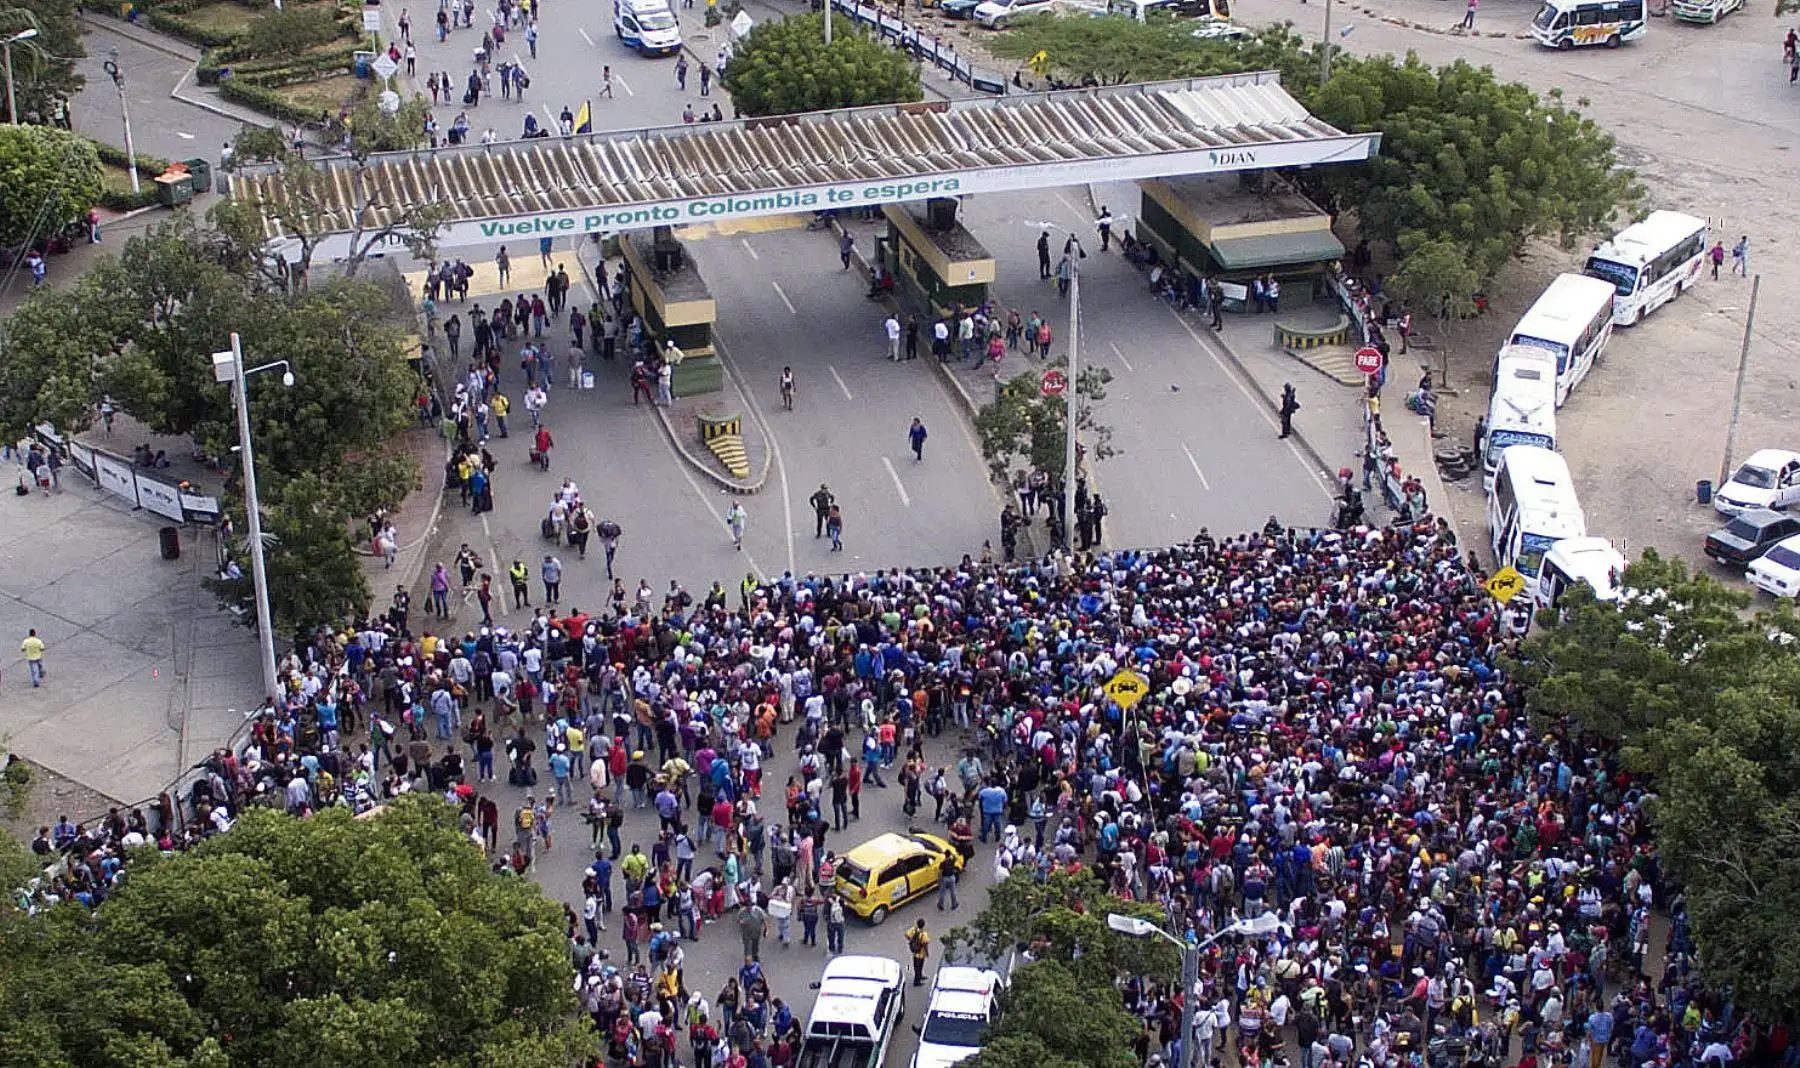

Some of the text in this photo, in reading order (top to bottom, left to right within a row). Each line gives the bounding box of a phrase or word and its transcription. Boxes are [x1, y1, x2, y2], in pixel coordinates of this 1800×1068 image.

[1220, 151, 1256, 165] DIAN
[480, 178, 960, 237] Vuelve pronto Colombia te espera
[1357, 355, 1378, 367] PARE
